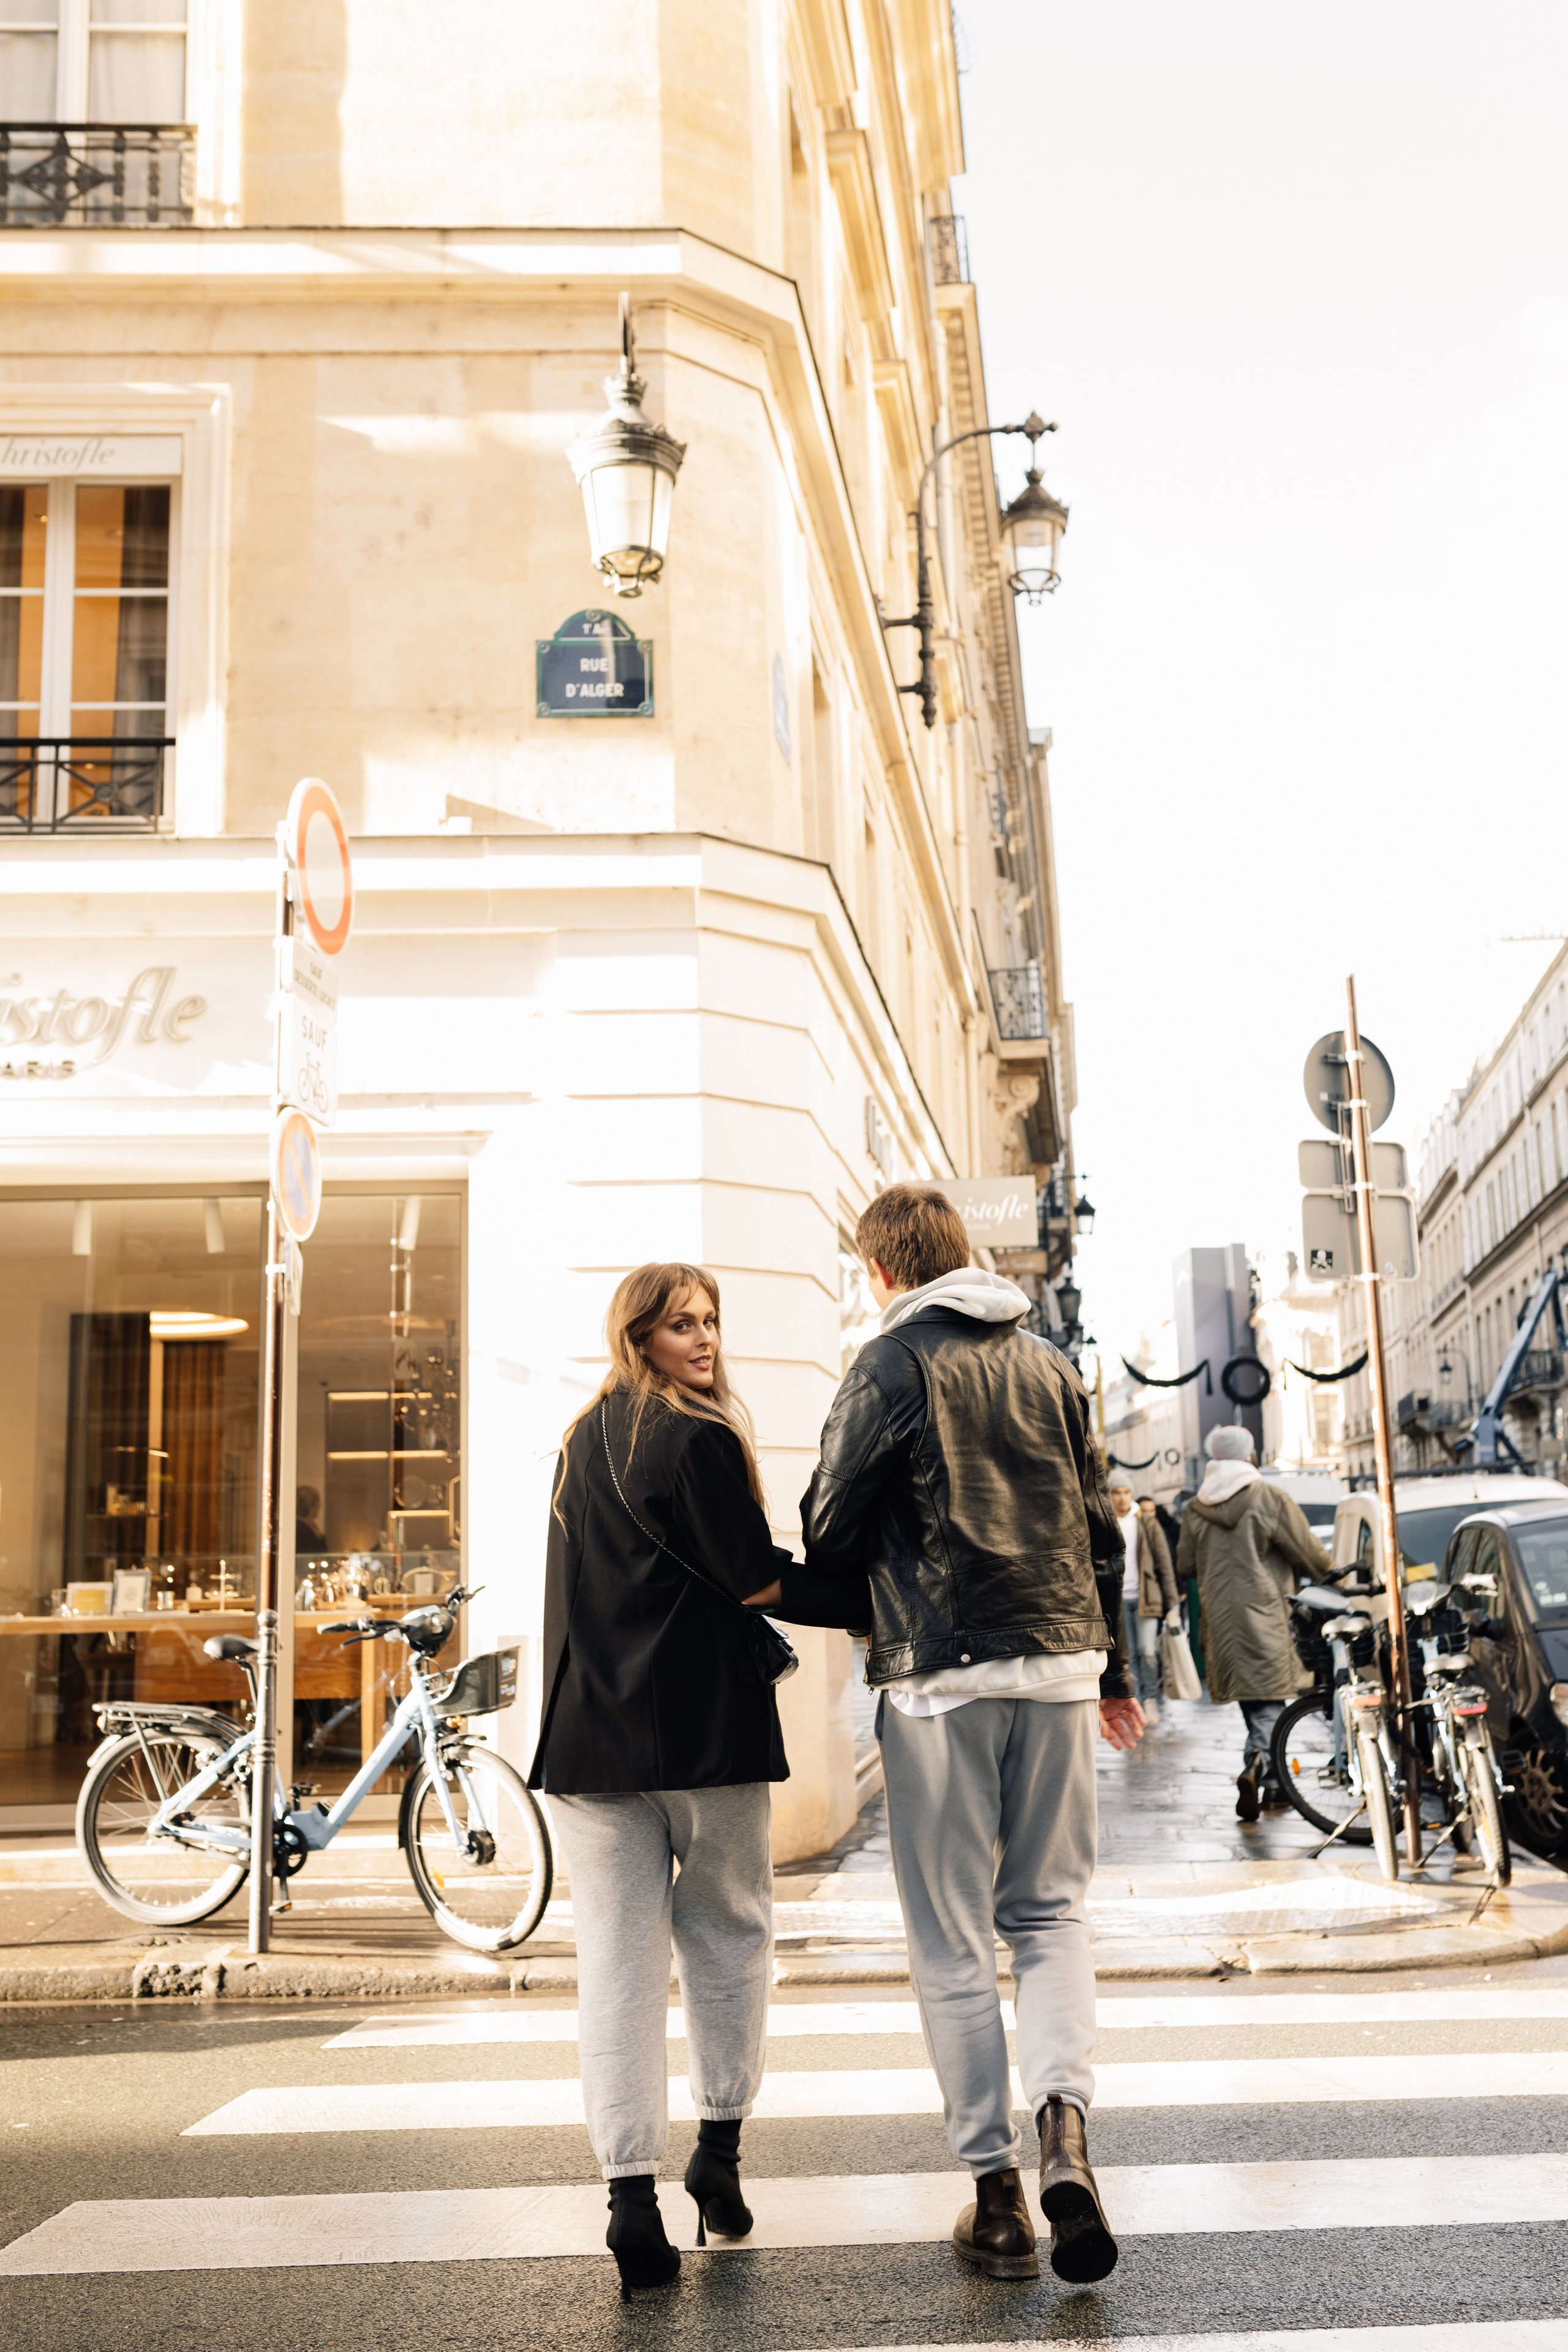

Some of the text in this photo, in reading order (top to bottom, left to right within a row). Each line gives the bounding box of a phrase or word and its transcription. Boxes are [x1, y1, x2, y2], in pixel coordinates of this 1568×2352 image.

[579, 657, 609, 673] RUE
[565, 683, 624, 698] D'ALGER
[302, 1015, 327, 1051] SAUF
